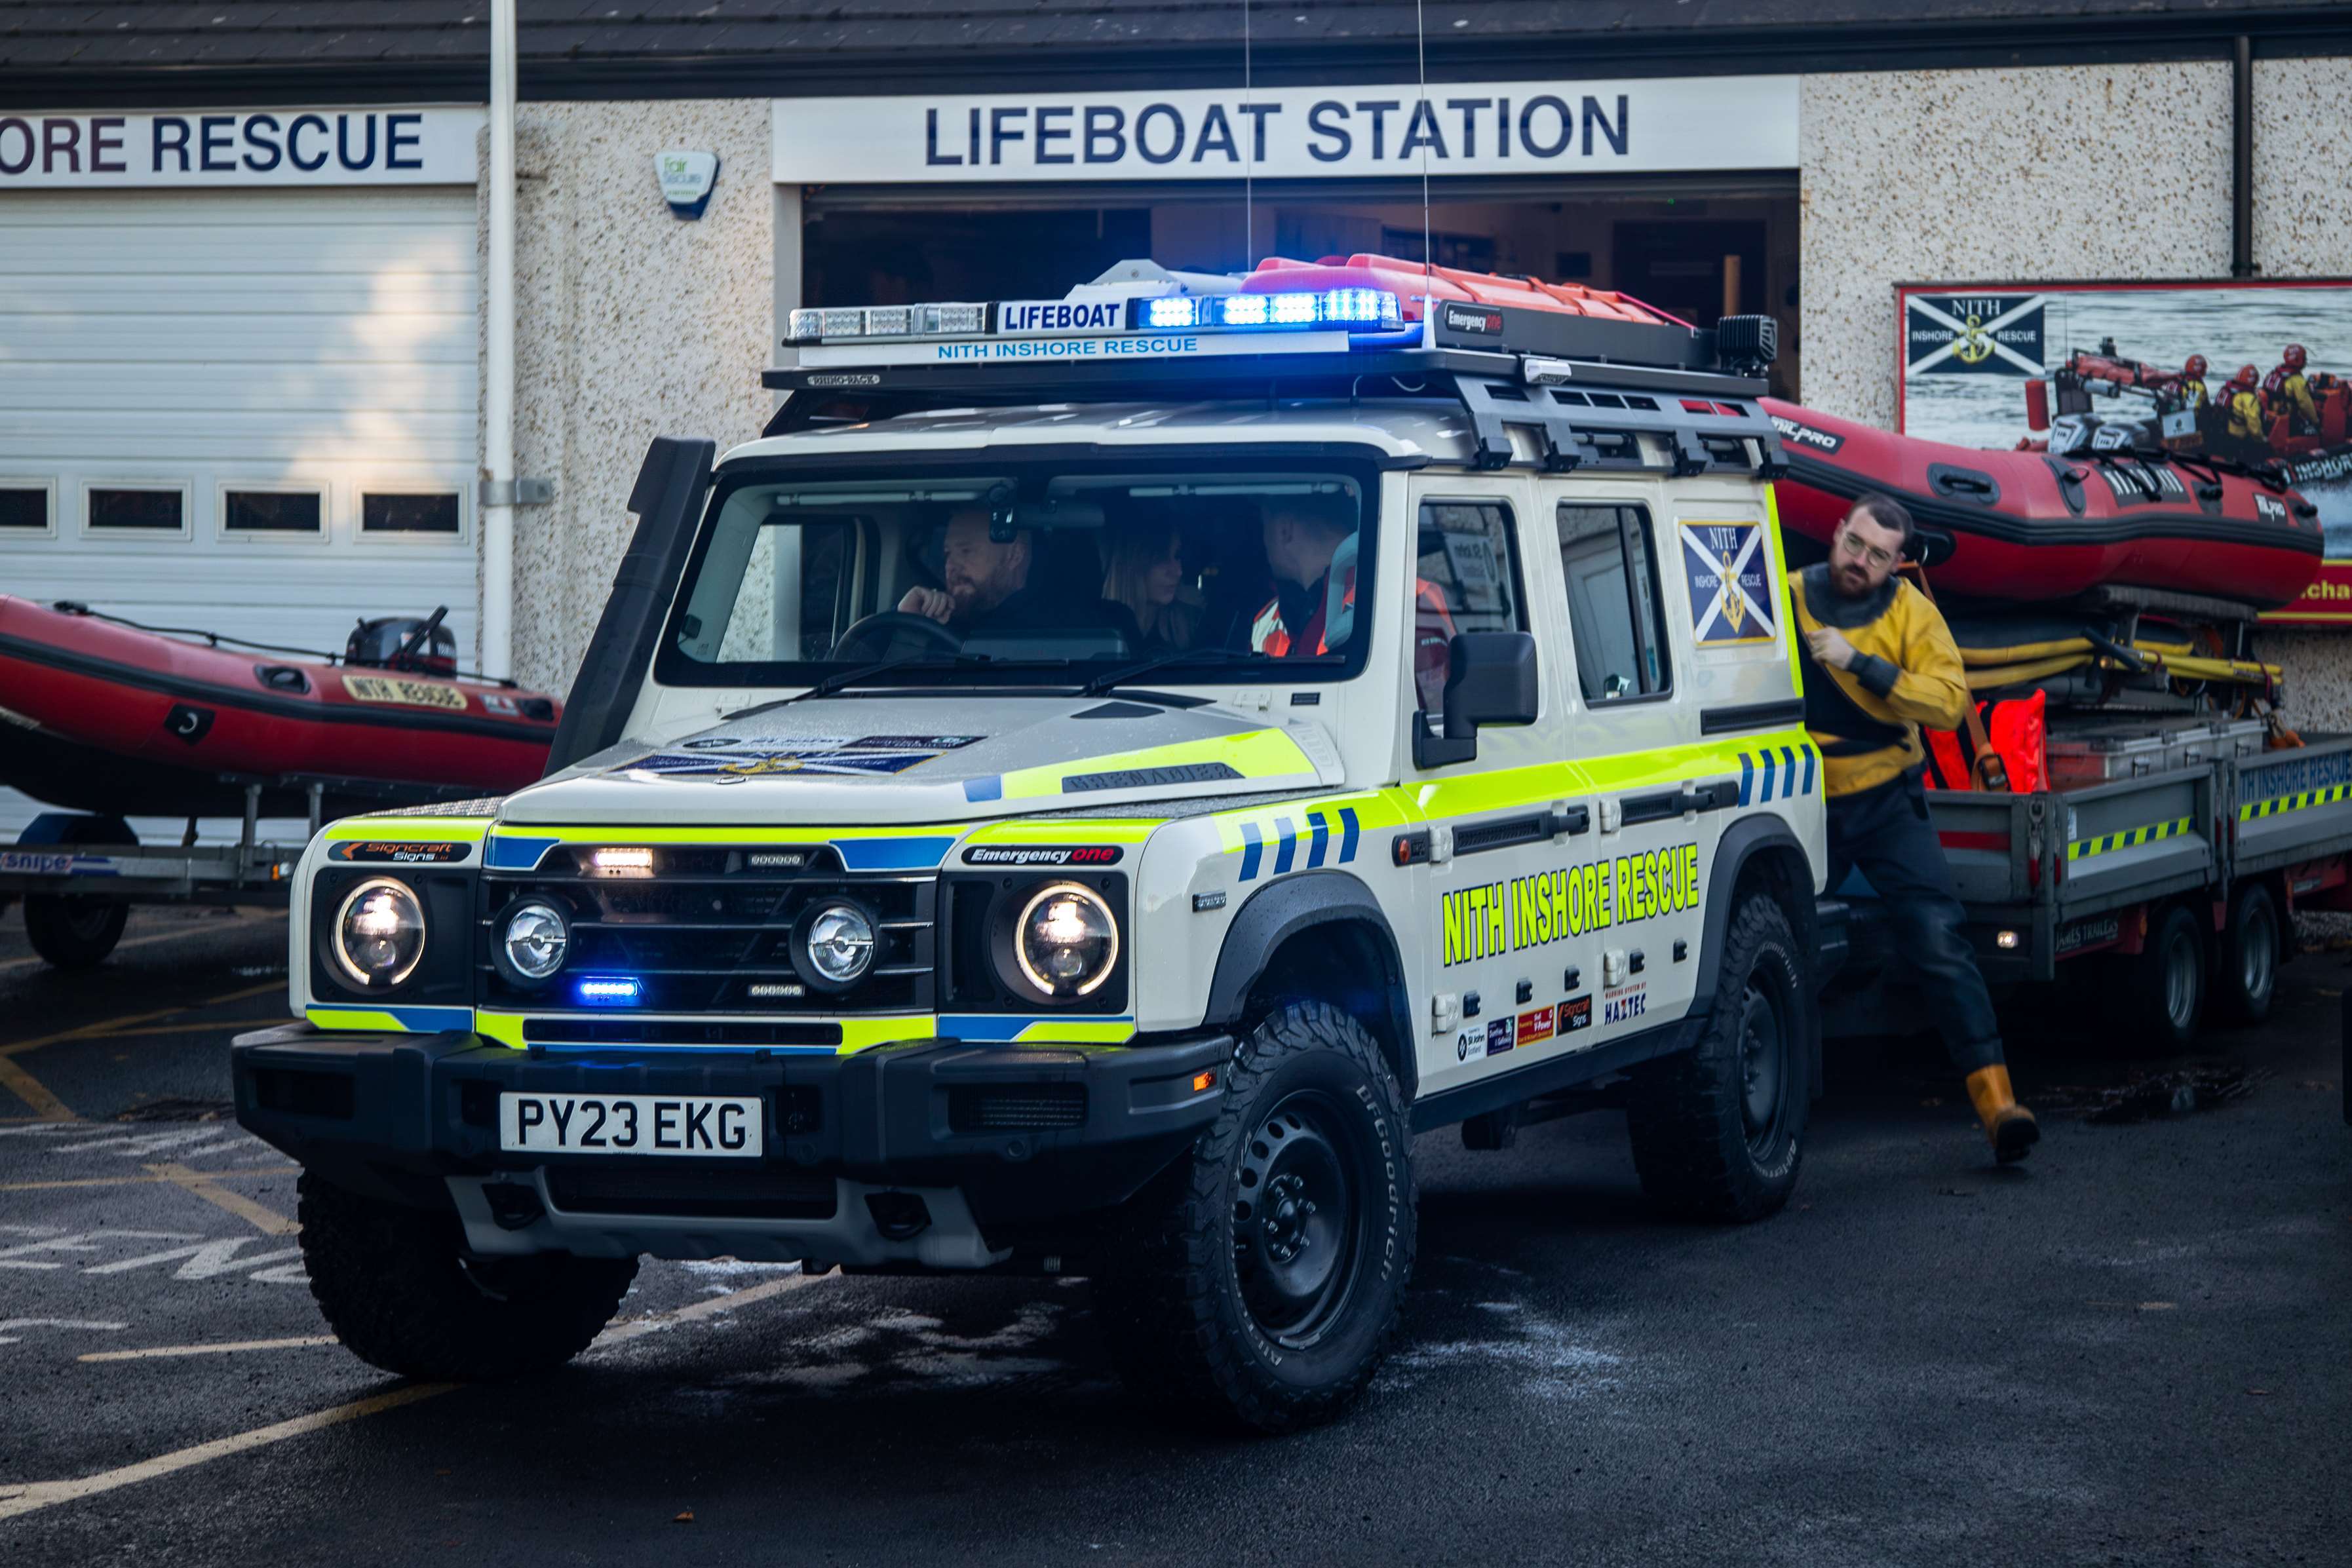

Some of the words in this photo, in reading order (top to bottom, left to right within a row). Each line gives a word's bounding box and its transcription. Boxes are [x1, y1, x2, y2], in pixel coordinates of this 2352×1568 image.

[151, 113, 423, 172] RESCUE
[925, 102, 1282, 166] LIFEBOAT
[1307, 94, 1630, 163] STATION
[1004, 303, 1121, 330] LIFEBOAT
[1952, 299, 2001, 316] NITH
[938, 344, 988, 360] NITH
[995, 340, 1097, 356] INSHORE
[1104, 337, 1198, 354] RESCUE
[1912, 330, 1955, 343] INSHORE
[1997, 330, 2037, 343] RESCUE
[2295, 451, 2352, 482] INSHOR
[1708, 527, 1738, 550] NITH
[2309, 751, 2352, 789] RESCUE
[365, 842, 453, 854] Signcraft
[393, 851, 436, 862] Signs
[970, 848, 1073, 864] Emergency
[1442, 881, 1506, 968] NITH
[1511, 859, 1611, 951] INSHORE
[1616, 842, 1699, 925] RESCUE
[1604, 992, 1646, 1026] HAZTEC
[517, 1098, 639, 1149] PY23
[654, 1101, 746, 1151] EKG
[1356, 1084, 1398, 1282] BFGoodrich
